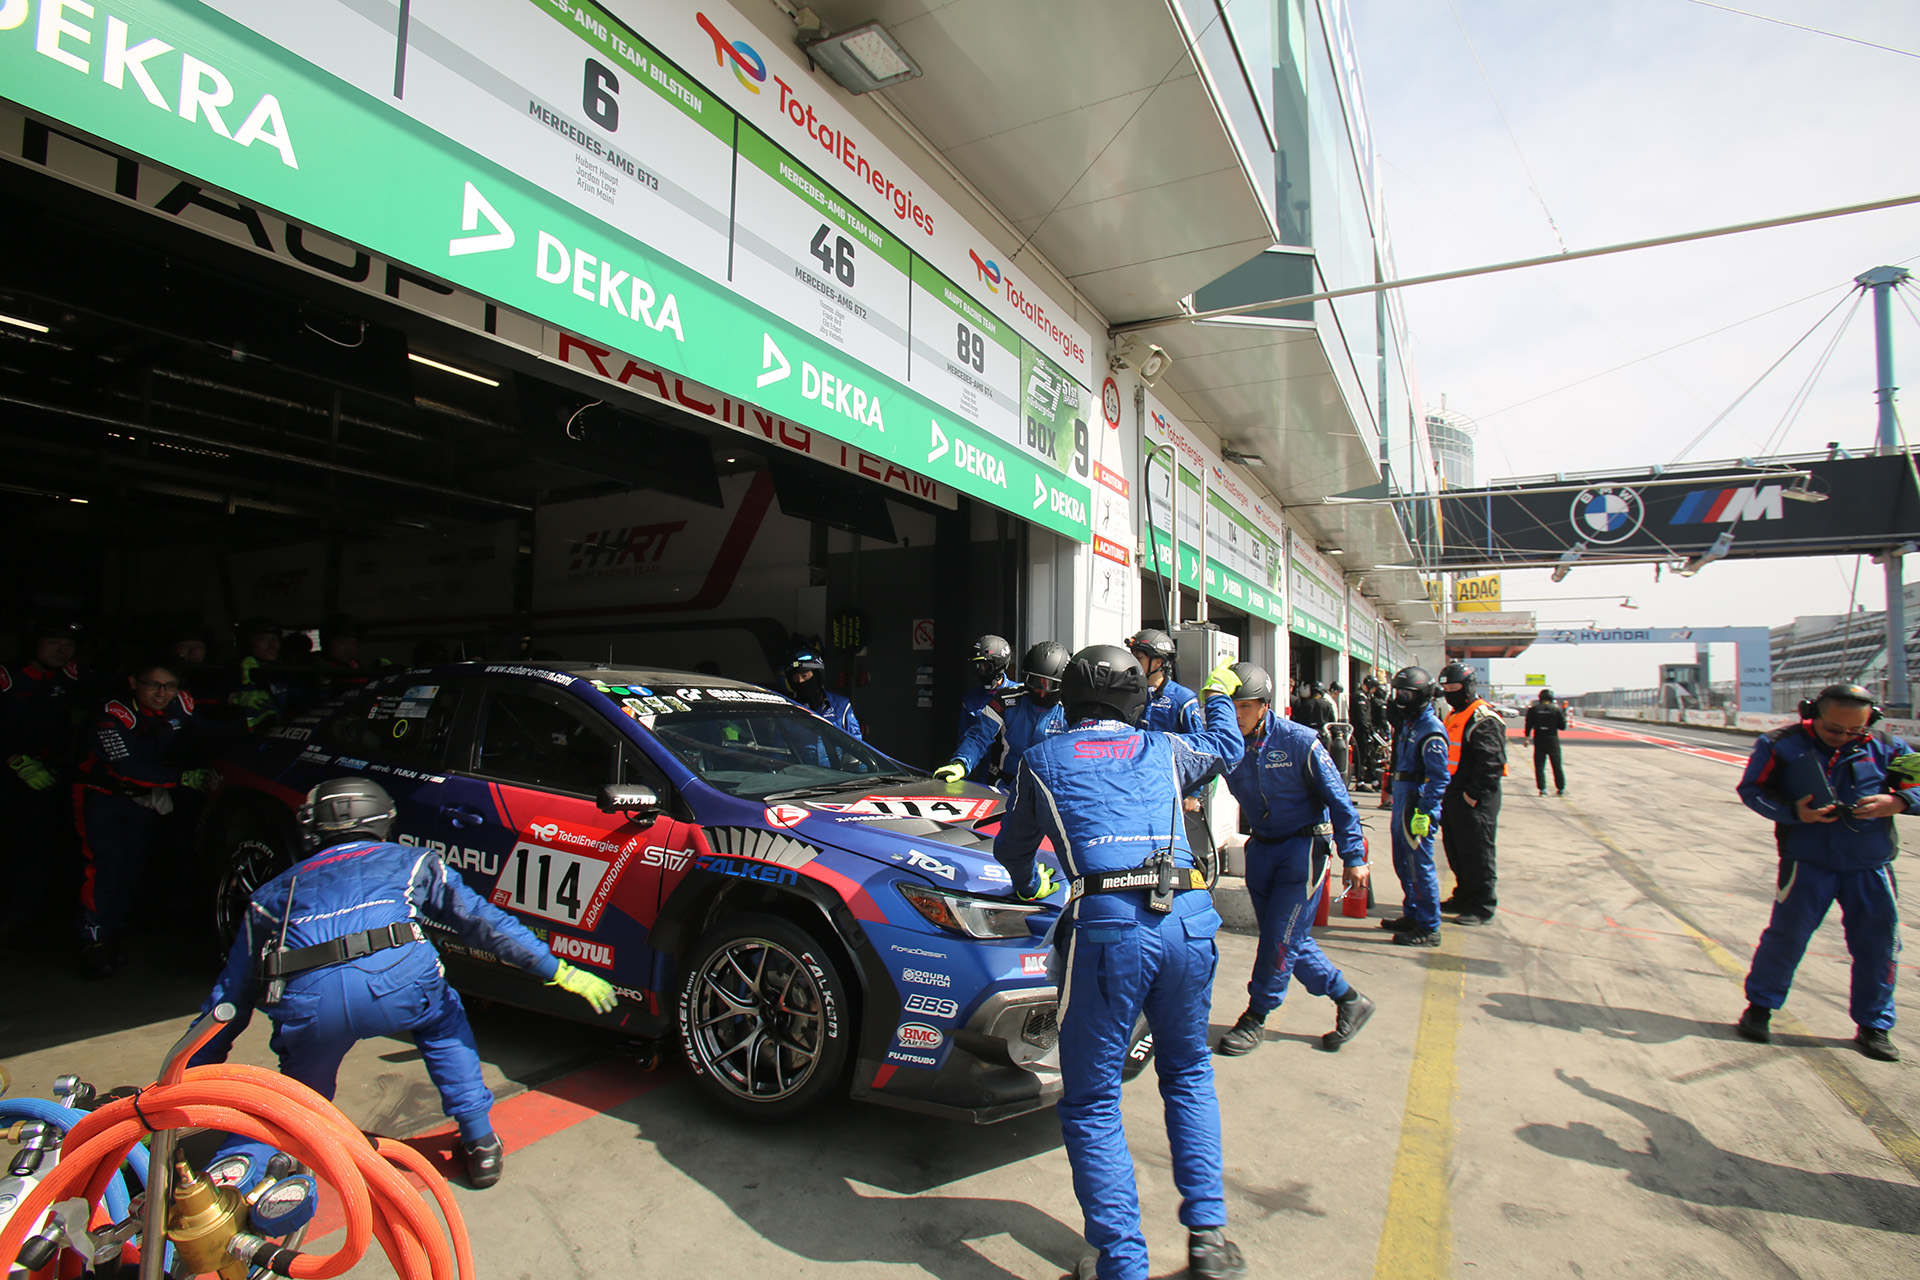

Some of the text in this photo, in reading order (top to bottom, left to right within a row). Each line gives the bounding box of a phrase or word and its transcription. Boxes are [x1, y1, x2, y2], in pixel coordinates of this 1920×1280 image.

[610, 33, 648, 73] TEAM
[650, 63, 703, 114] BILSTEIN
[582, 57, 620, 133] 6
[529, 100, 659, 192] MERCEDES-AMG GT3
[773, 75, 934, 236] TotalEnergies
[575, 153, 598, 175] Hubert
[779, 161, 883, 248] MERCEDES-AMG TEAM HRT
[809, 222, 856, 288] 46
[536, 229, 685, 343] DEKRA
[795, 266, 867, 320] MERCEDES-AMG GT2
[1003, 276, 1085, 365] TotalEnergies
[957, 321, 984, 375] 89
[947, 362, 983, 394] MERCEDES-AMG
[801, 360, 885, 433] DEKRA
[1027, 414, 1089, 478] BOX 9
[1165, 422, 1204, 468] TotalEnergies
[954, 438, 1007, 490] DEKRA
[1050, 487, 1087, 526] DEKRA
[1579, 487, 1635, 504] BMW
[1100, 541, 1125, 561] ACHTUNG
[1459, 578, 1499, 602] ADAC
[1581, 630, 1649, 642] HYUNDAI
[1265, 761, 1293, 770] SUBARU
[868, 801, 964, 817] 114
[558, 829, 620, 853] TotalEnergies
[1086, 834, 1181, 848] STI Performane
[695, 855, 798, 886] FALKEN
[907, 848, 956, 881] TOA
[983, 864, 1011, 879] ST
[1102, 870, 1180, 889] mechanixm
[514, 848, 582, 921] 114
[585, 837, 639, 929] ADAC NORDRHEIN
[552, 935, 613, 967] MOTUL
[914, 970, 951, 982] OGURA
[914, 977, 951, 988] CLUTCH
[613, 985, 643, 1002] CARO
[904, 993, 959, 1019] BBS
[903, 1027, 939, 1043] BMC
[888, 1052, 936, 1066] FUJITSUBO
